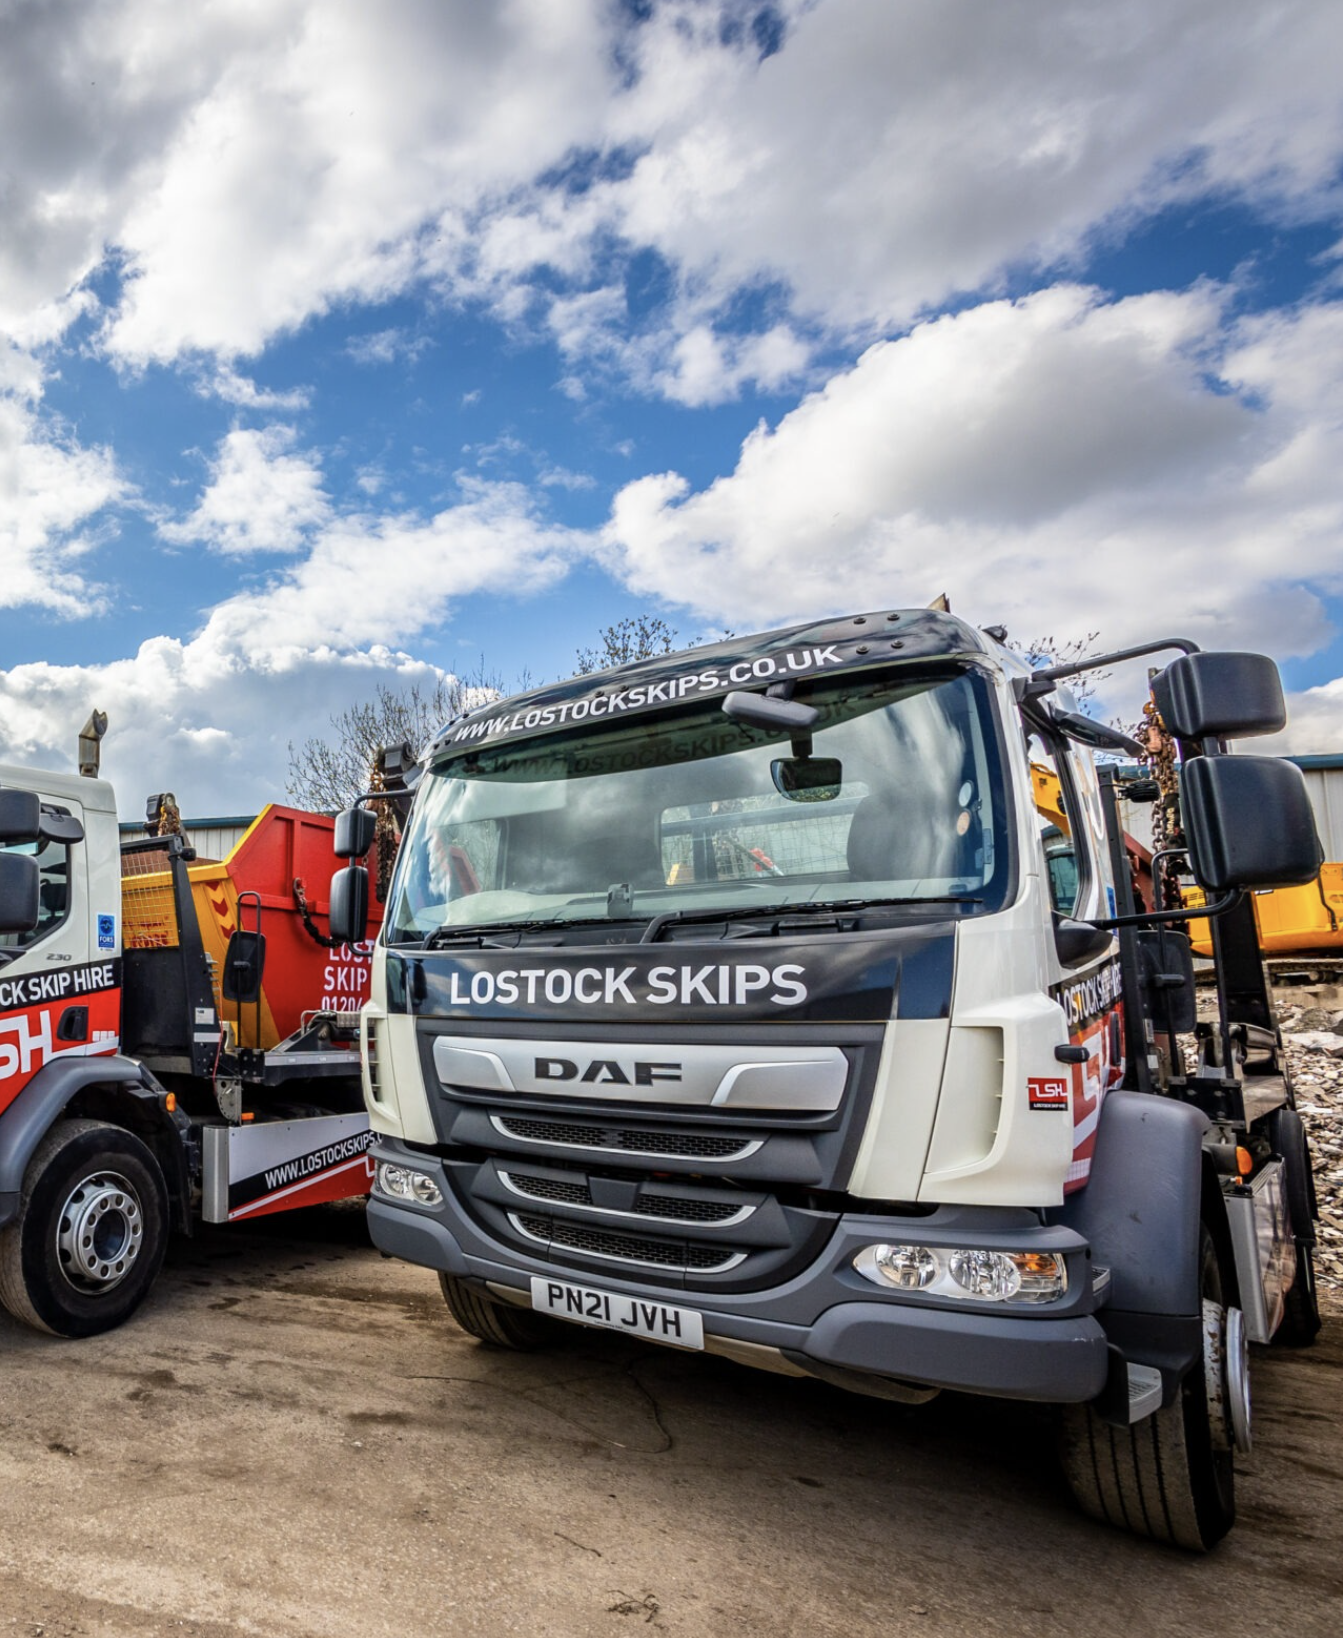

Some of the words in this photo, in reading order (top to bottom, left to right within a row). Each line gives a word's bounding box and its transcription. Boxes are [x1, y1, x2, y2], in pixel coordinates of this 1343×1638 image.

[455, 645, 844, 743] WWW.LOSTOCKSKIPS.CO.UK
[46, 953, 72, 962] 230
[29, 972, 71, 1001] SKIP
[74, 964, 115, 992] HIRE
[324, 966, 367, 991] SKIP
[451, 966, 637, 1005] LOSTOCK
[646, 964, 808, 1006] SKIPS
[535, 1057, 683, 1086] DAF
[548, 1283, 611, 1321] PN21
[621, 1301, 682, 1338] JVH
